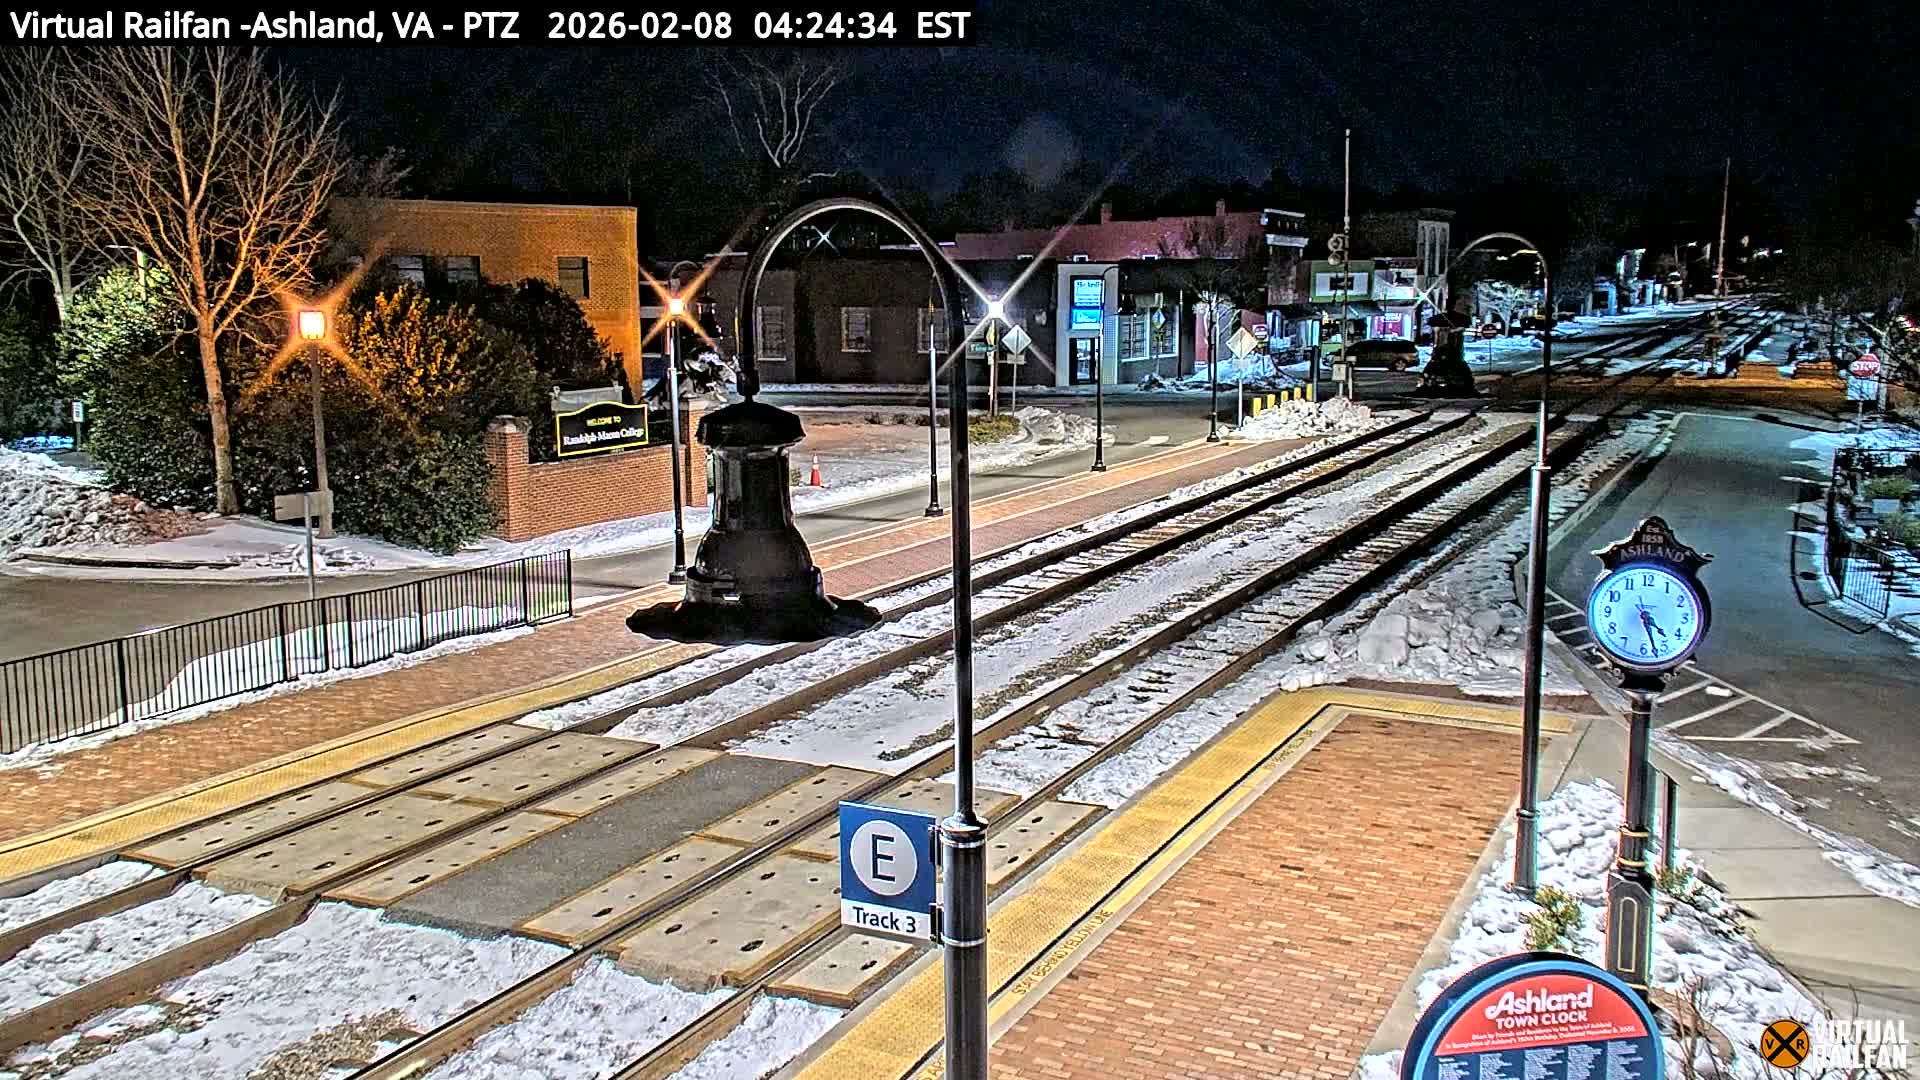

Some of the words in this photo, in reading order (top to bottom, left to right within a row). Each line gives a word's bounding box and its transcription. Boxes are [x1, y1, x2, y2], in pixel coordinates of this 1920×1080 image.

[1852, 361, 1879, 371] STOP
[1620, 544, 1685, 563] ASHLAND
[1624, 577, 1635, 591] 11
[1642, 574, 1655, 587] 12
[1663, 581, 1671, 594] 1
[1608, 590, 1621, 603] 10
[1676, 595, 1685, 608] 2
[1603, 606, 1612, 618] 9
[1680, 612, 1689, 625] 3
[1607, 621, 1617, 635] 8
[1674, 627, 1682, 641] 4
[1620, 637, 1629, 650] 7
[1639, 642, 1648, 656] 6
[1659, 640, 1669, 652] 5
[871, 833, 896, 882] E
[852, 906, 900, 932] Track
[905, 915, 917, 933] 3
[1485, 984, 1594, 1020] Ashland
[1496, 1015, 1539, 1030] TOWN
[1541, 1010, 1588, 1026] CLOCK
